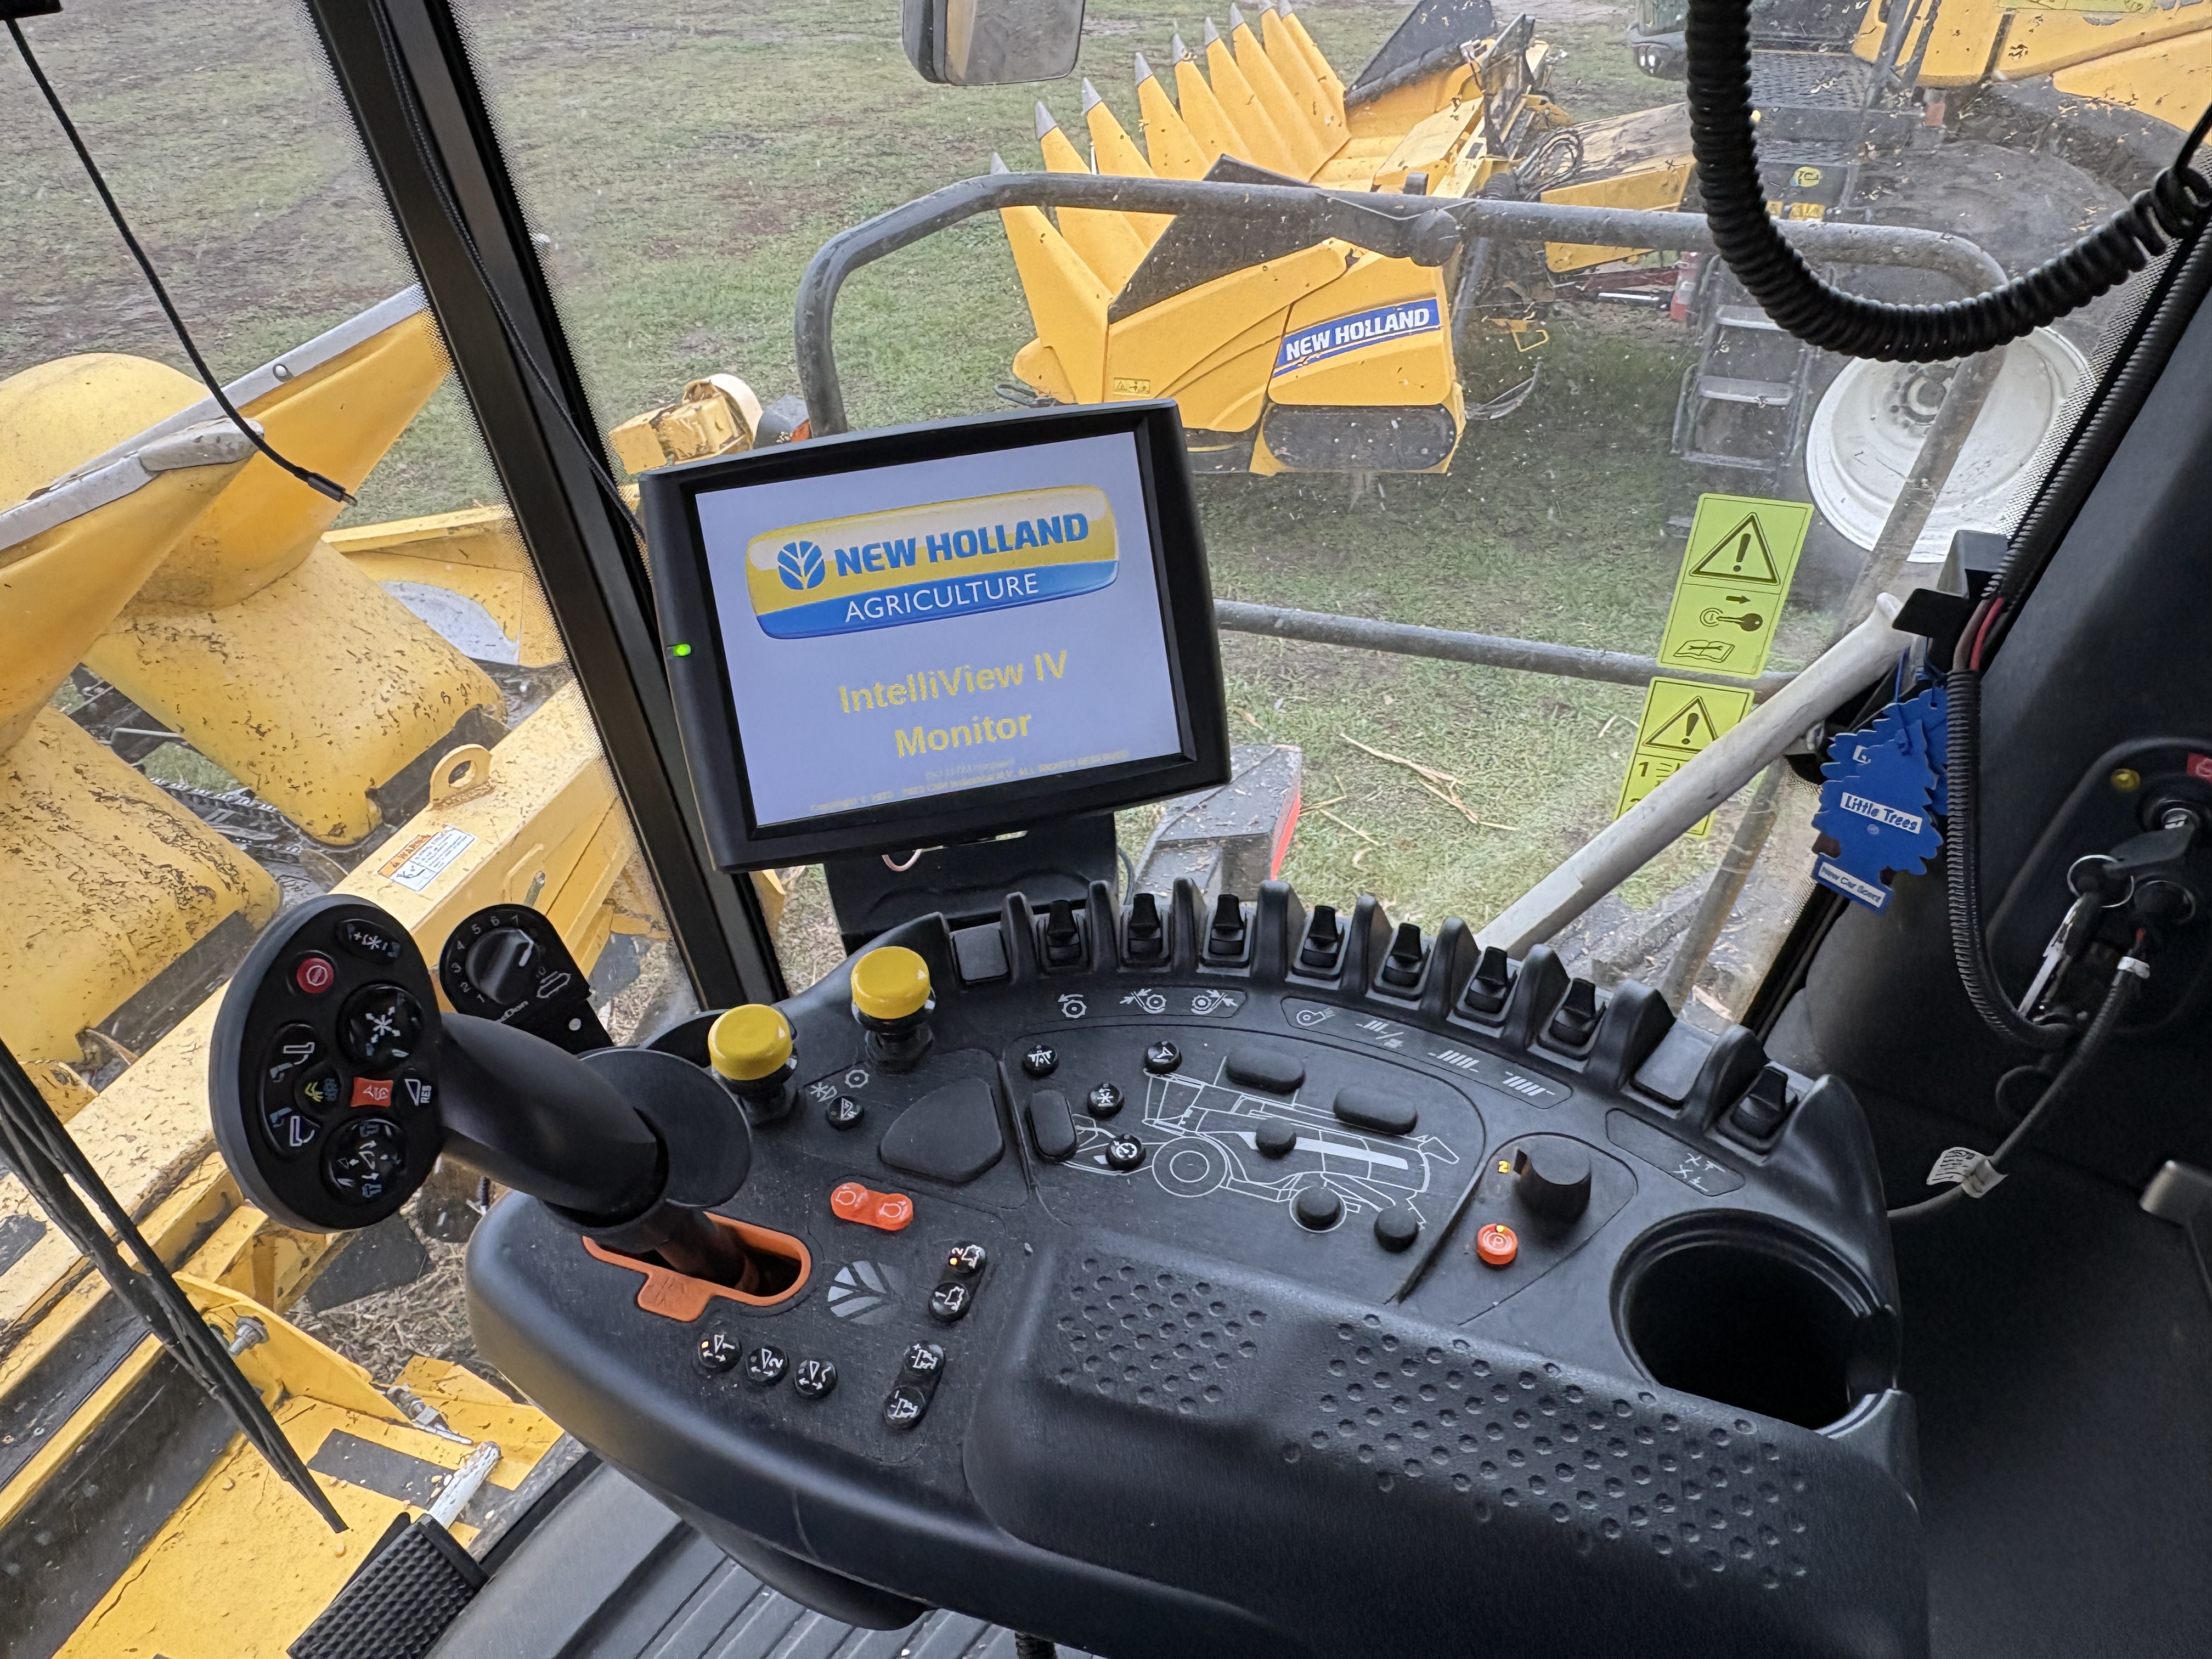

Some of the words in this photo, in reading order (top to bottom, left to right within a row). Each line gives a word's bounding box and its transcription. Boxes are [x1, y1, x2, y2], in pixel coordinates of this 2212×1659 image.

[1286, 330, 1330, 361] NEW
[1335, 308, 1430, 345] HOLLAND
[834, 537, 916, 577] NEW
[926, 512, 1089, 563] HOLLAND
[845, 573, 1039, 622] AGRICULTURE
[839, 663, 1024, 713] IntelliView
[1034, 650, 1067, 682] IV
[894, 714, 1032, 758] Monitor
[1638, 761, 1649, 777] 1
[1845, 795, 1880, 817] Little
[1883, 808, 1918, 831] Trees
[471, 923, 481, 935] 5
[490, 916, 500, 926] 6
[1498, 1160, 1509, 1173] 2
[1492, 1237, 1504, 1246] P
